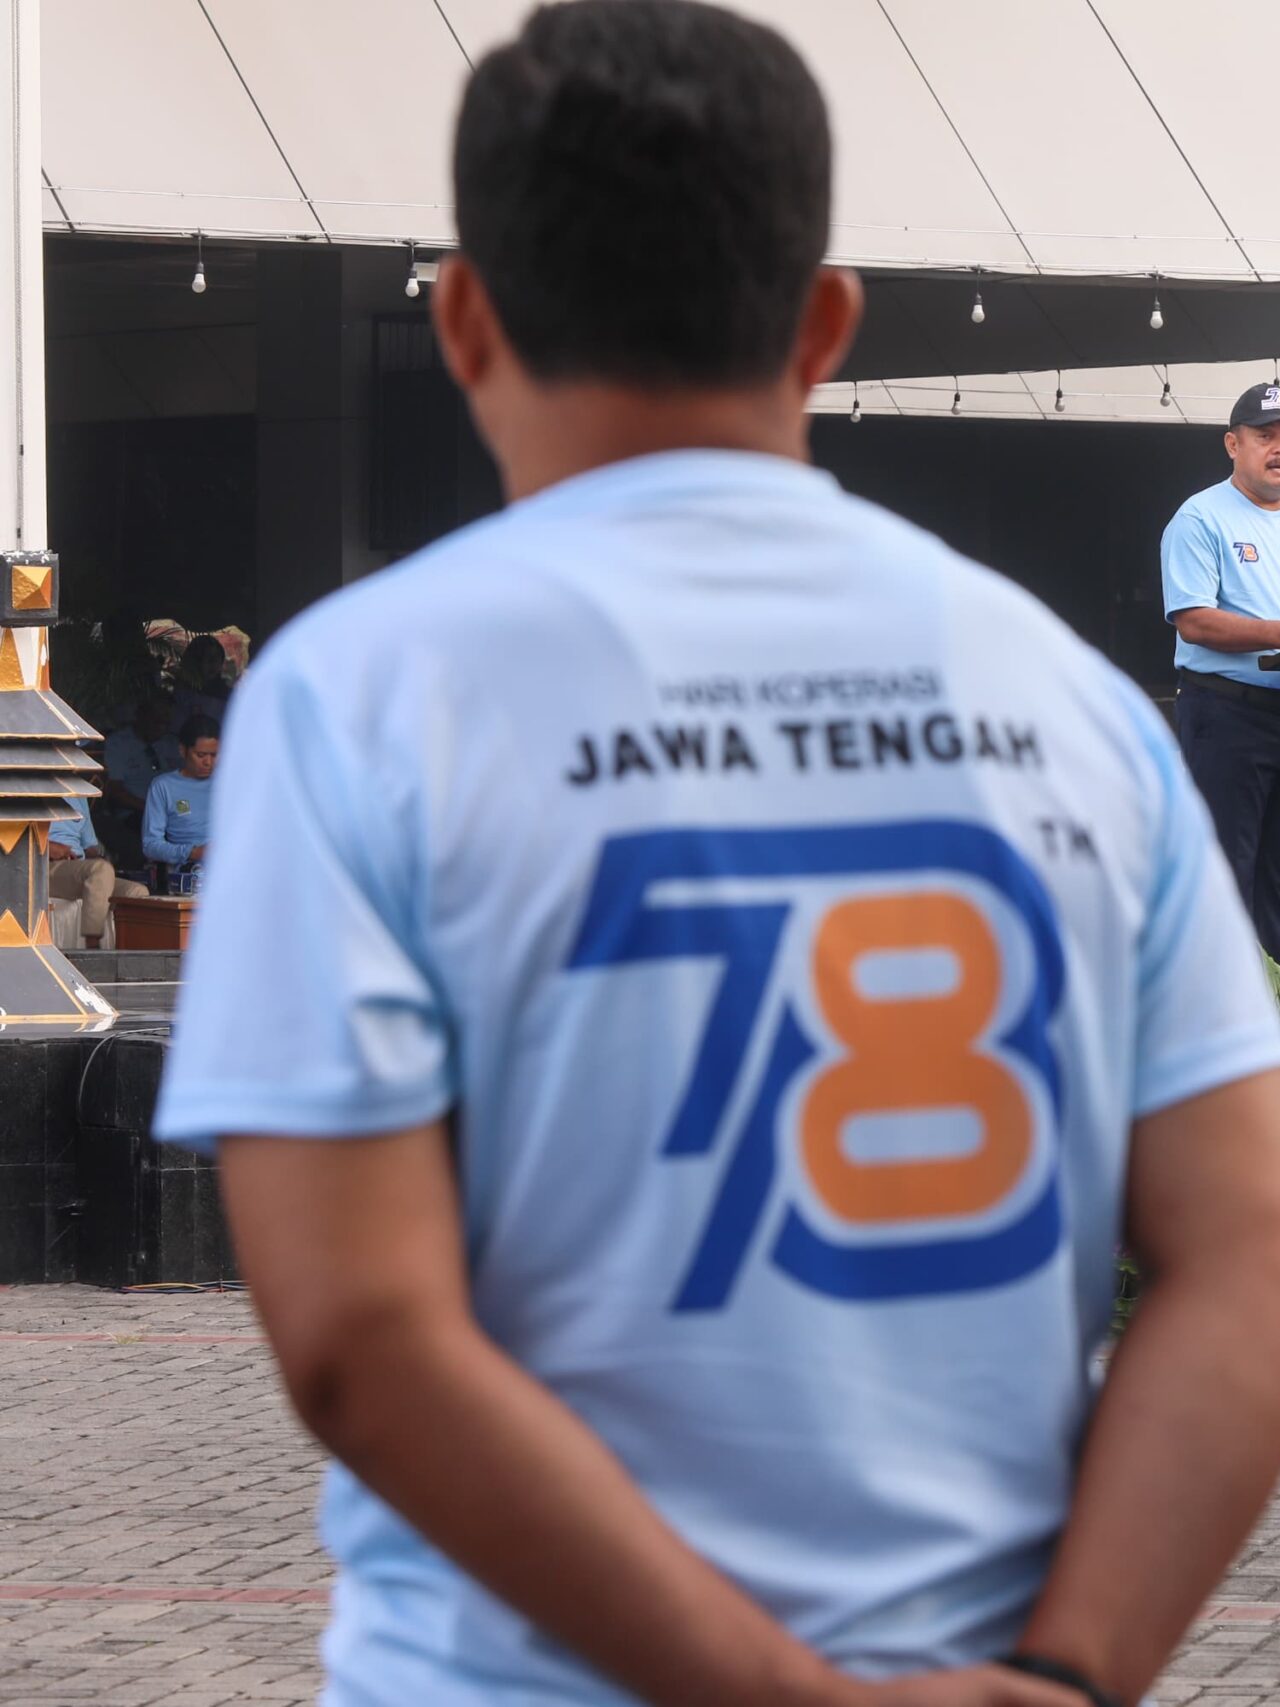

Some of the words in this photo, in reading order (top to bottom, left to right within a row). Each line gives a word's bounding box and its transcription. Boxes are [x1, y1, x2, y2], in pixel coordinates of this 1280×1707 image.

[566, 728, 760, 788] JAWA
[776, 712, 1044, 774] TENGAH
[562, 816, 1068, 1316] 78
